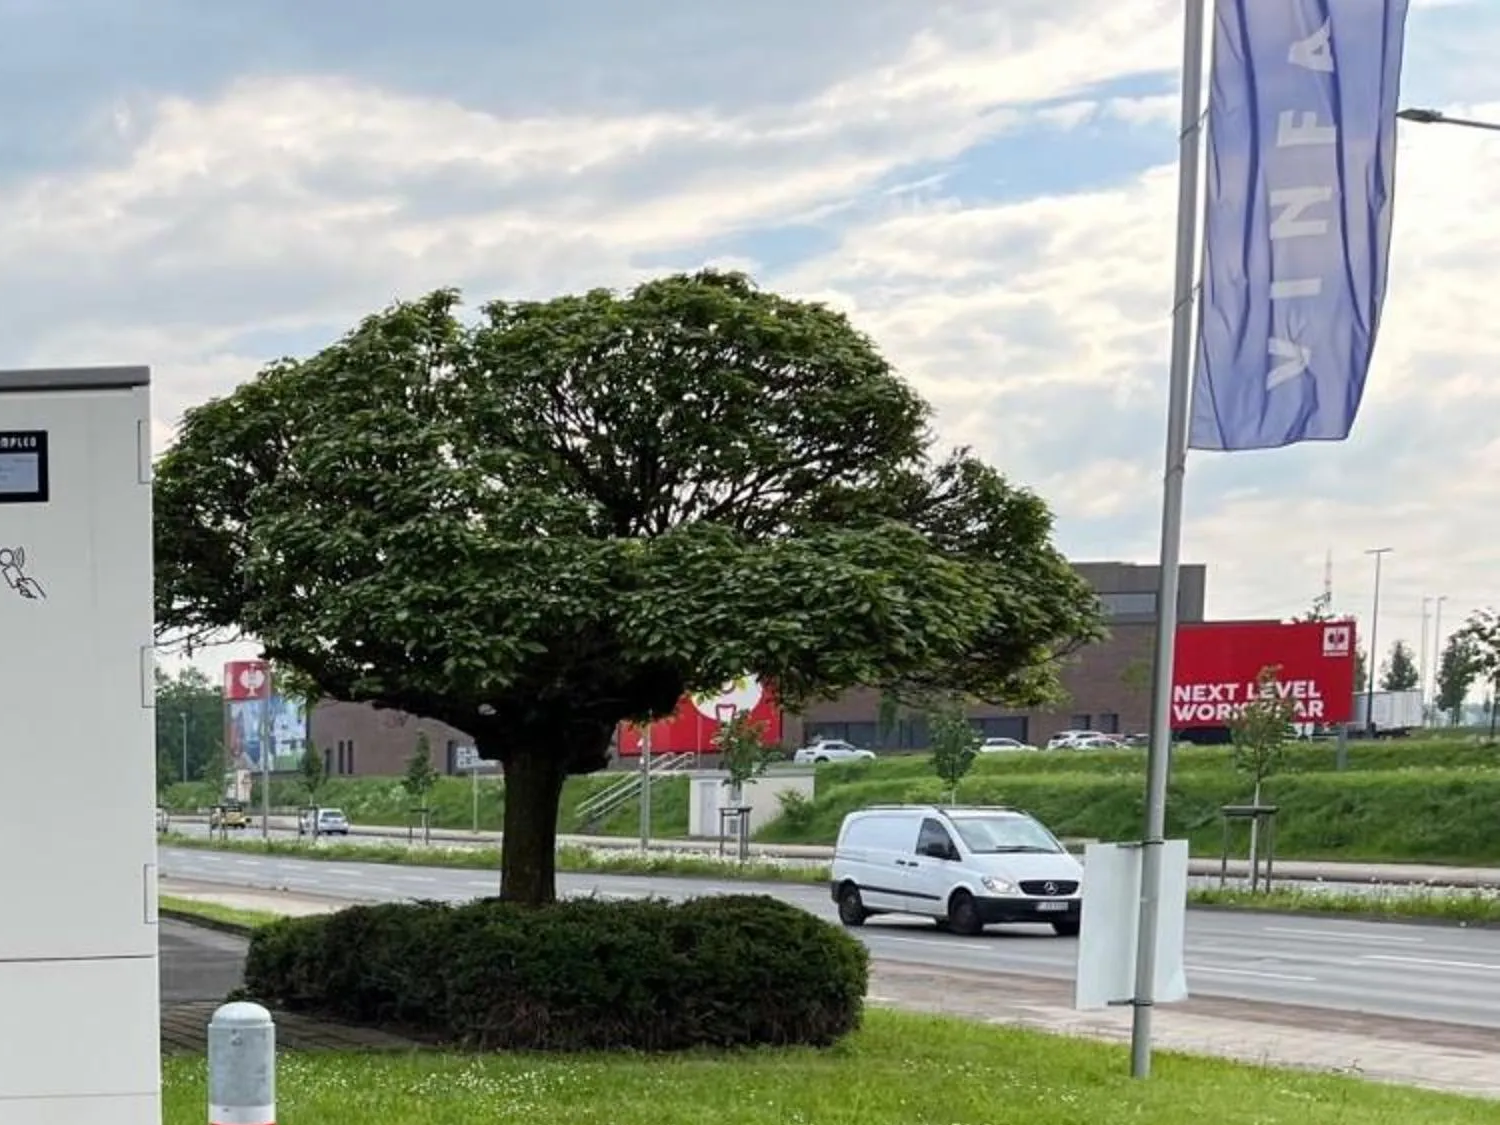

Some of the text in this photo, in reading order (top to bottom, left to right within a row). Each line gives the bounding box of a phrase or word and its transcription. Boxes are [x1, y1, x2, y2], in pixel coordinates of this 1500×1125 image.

[1173, 680, 1321, 702] NEXT LEVEL
[1173, 700, 1324, 722] WORKAR
